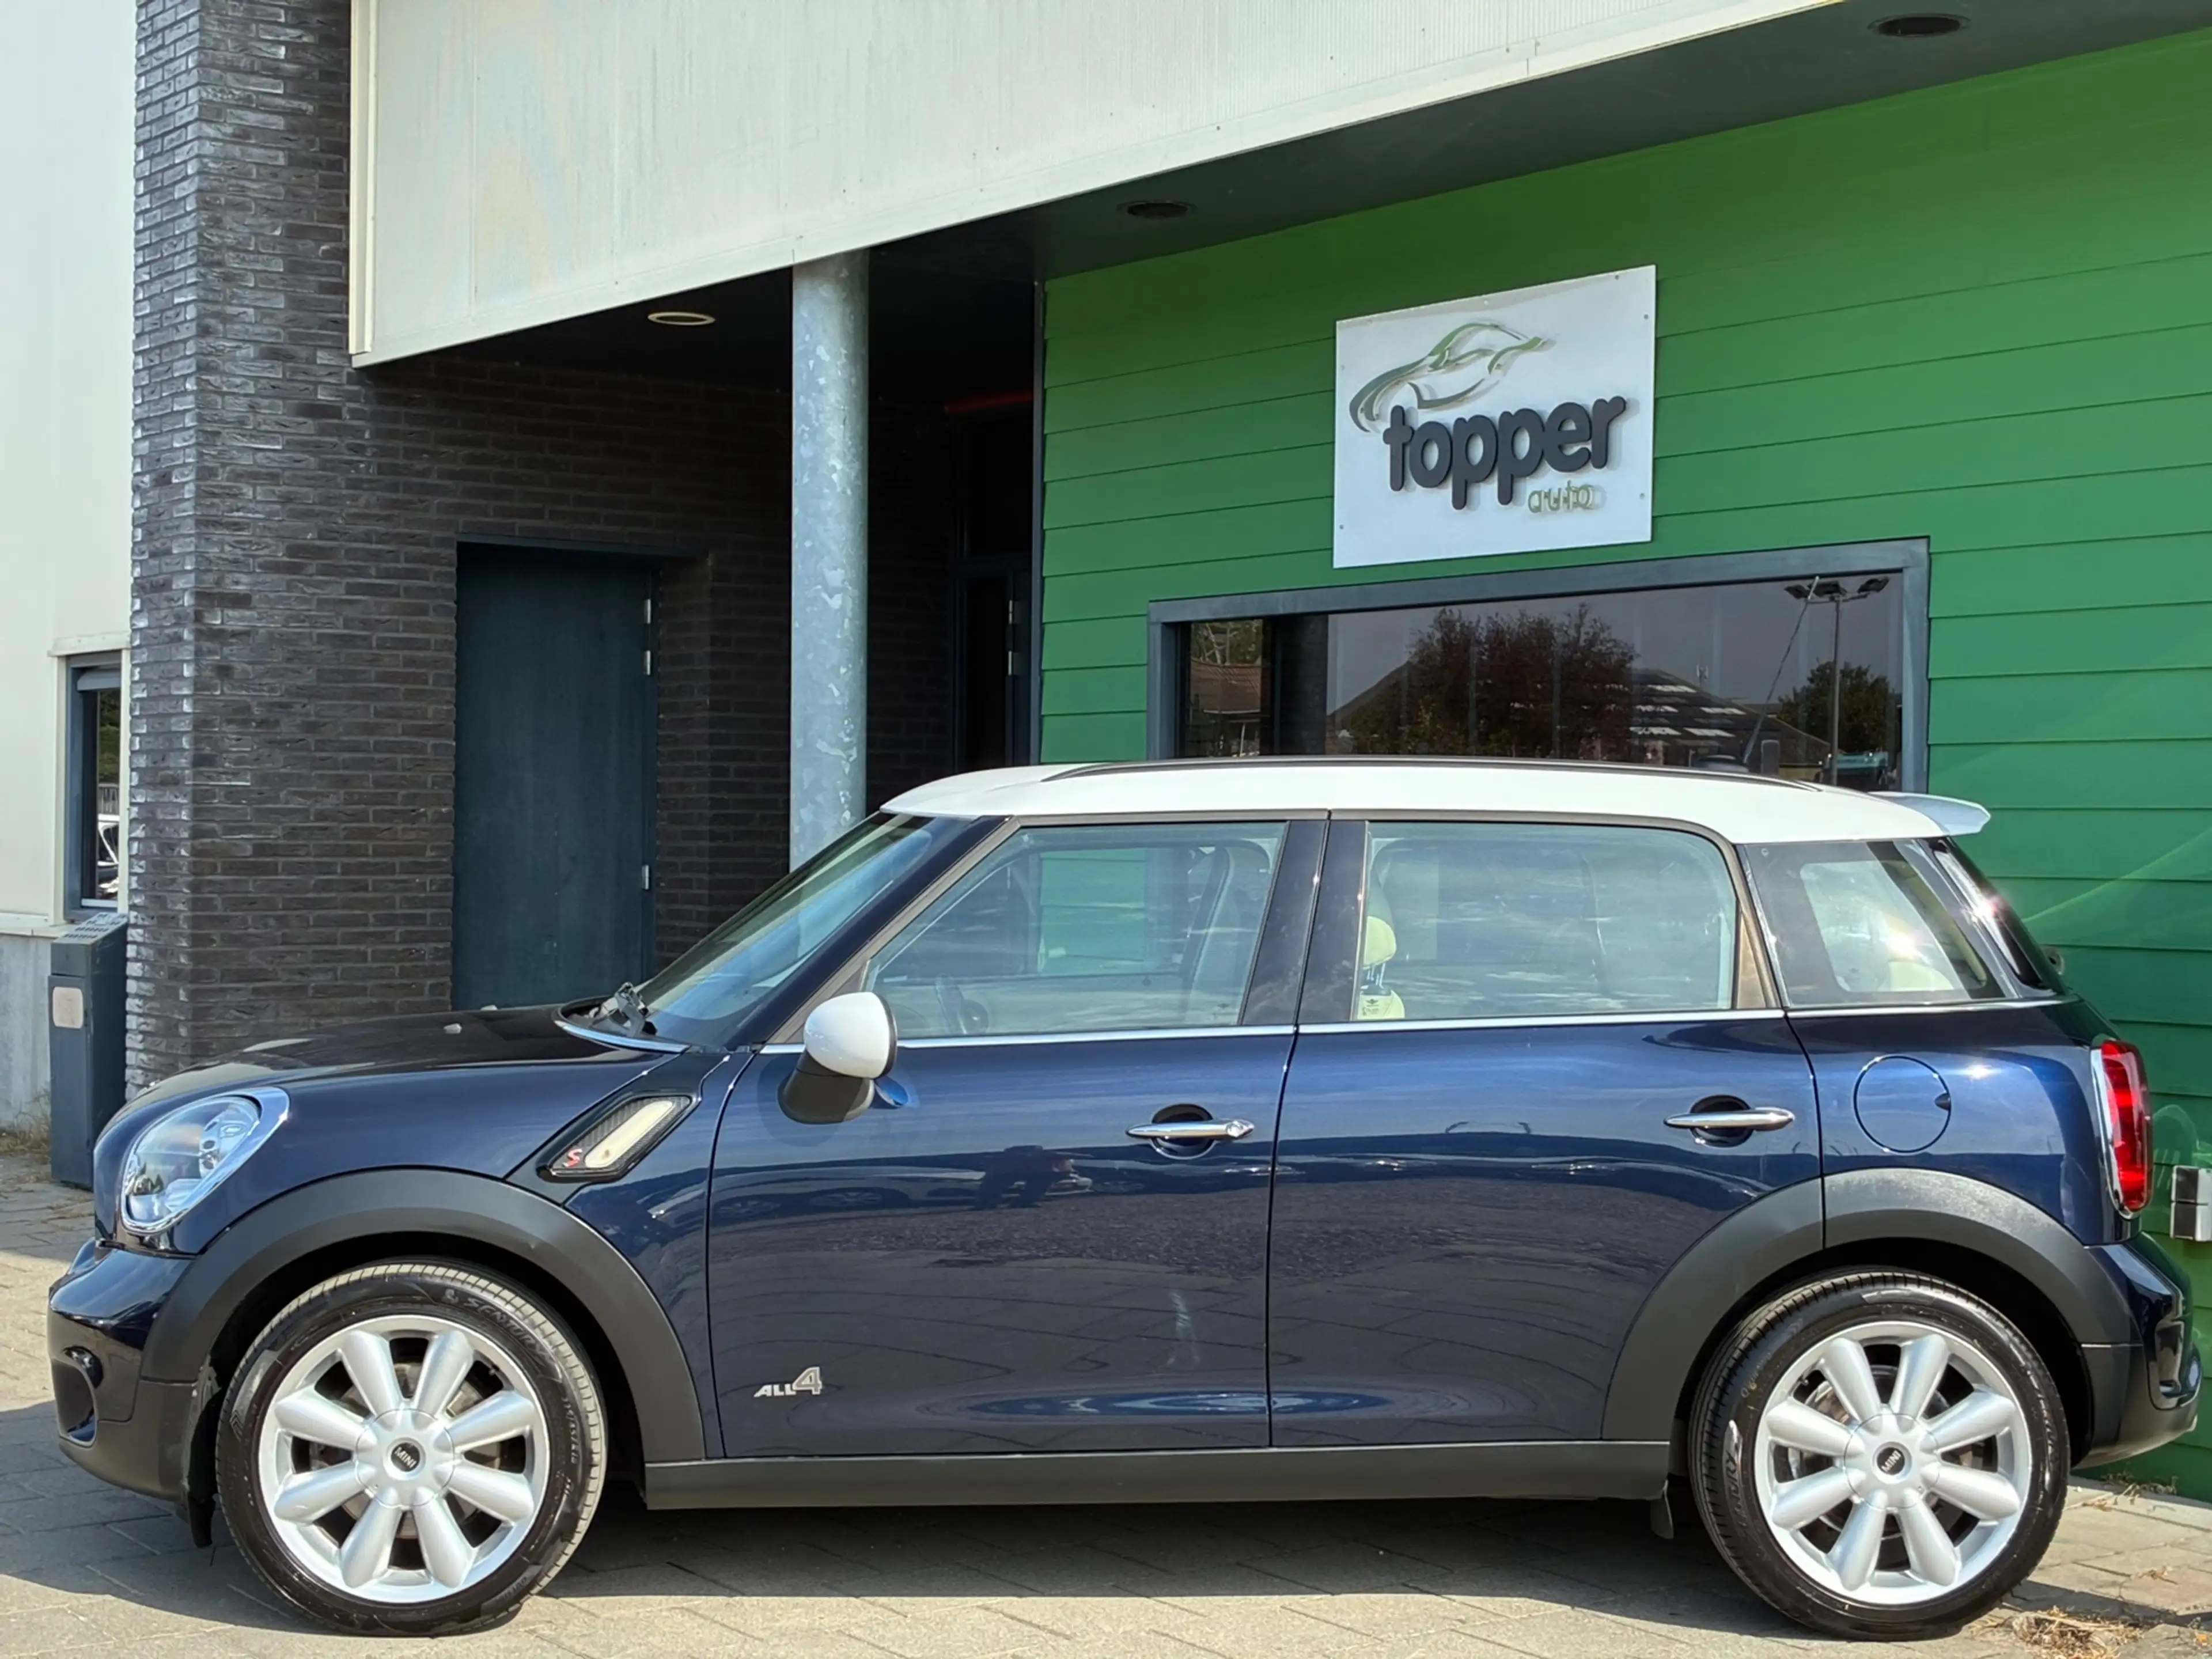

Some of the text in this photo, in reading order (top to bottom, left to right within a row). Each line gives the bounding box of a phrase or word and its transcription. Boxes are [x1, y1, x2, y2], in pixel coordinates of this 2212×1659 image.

[1382, 396, 1626, 510] topper
[1528, 480, 1593, 513] auto
[562, 1148, 583, 1167] S
[753, 1366, 823, 1397] ALL4
[394, 1446, 417, 1468] MINI
[1881, 1450, 1902, 1472] MINI
